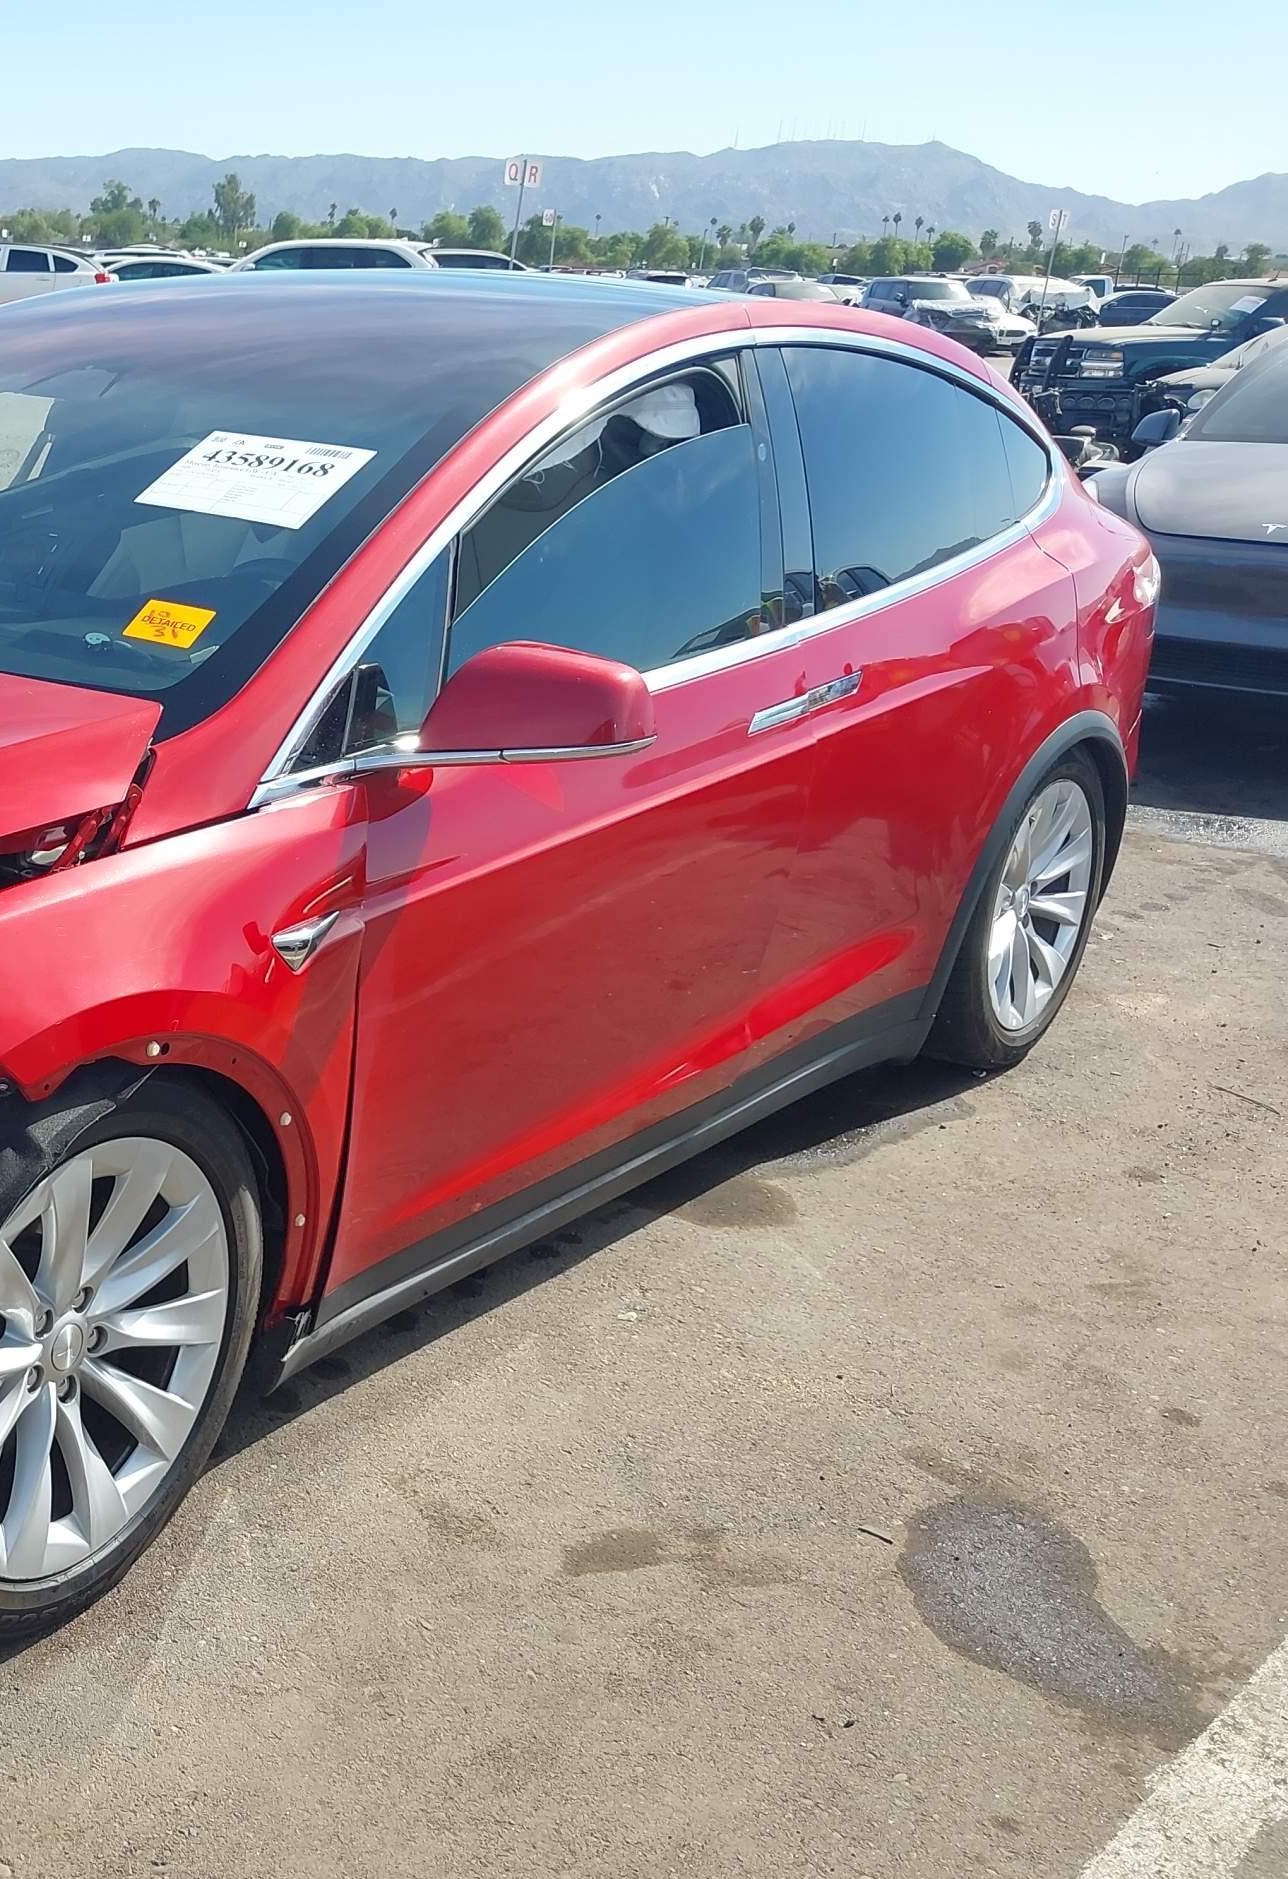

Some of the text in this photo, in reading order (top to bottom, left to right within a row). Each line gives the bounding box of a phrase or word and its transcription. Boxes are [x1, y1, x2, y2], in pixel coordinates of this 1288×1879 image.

[509, 163, 518, 181] Q
[528, 166, 538, 183] R
[202, 449, 335, 477] 43589168
[141, 615, 196, 632] DETAILED
